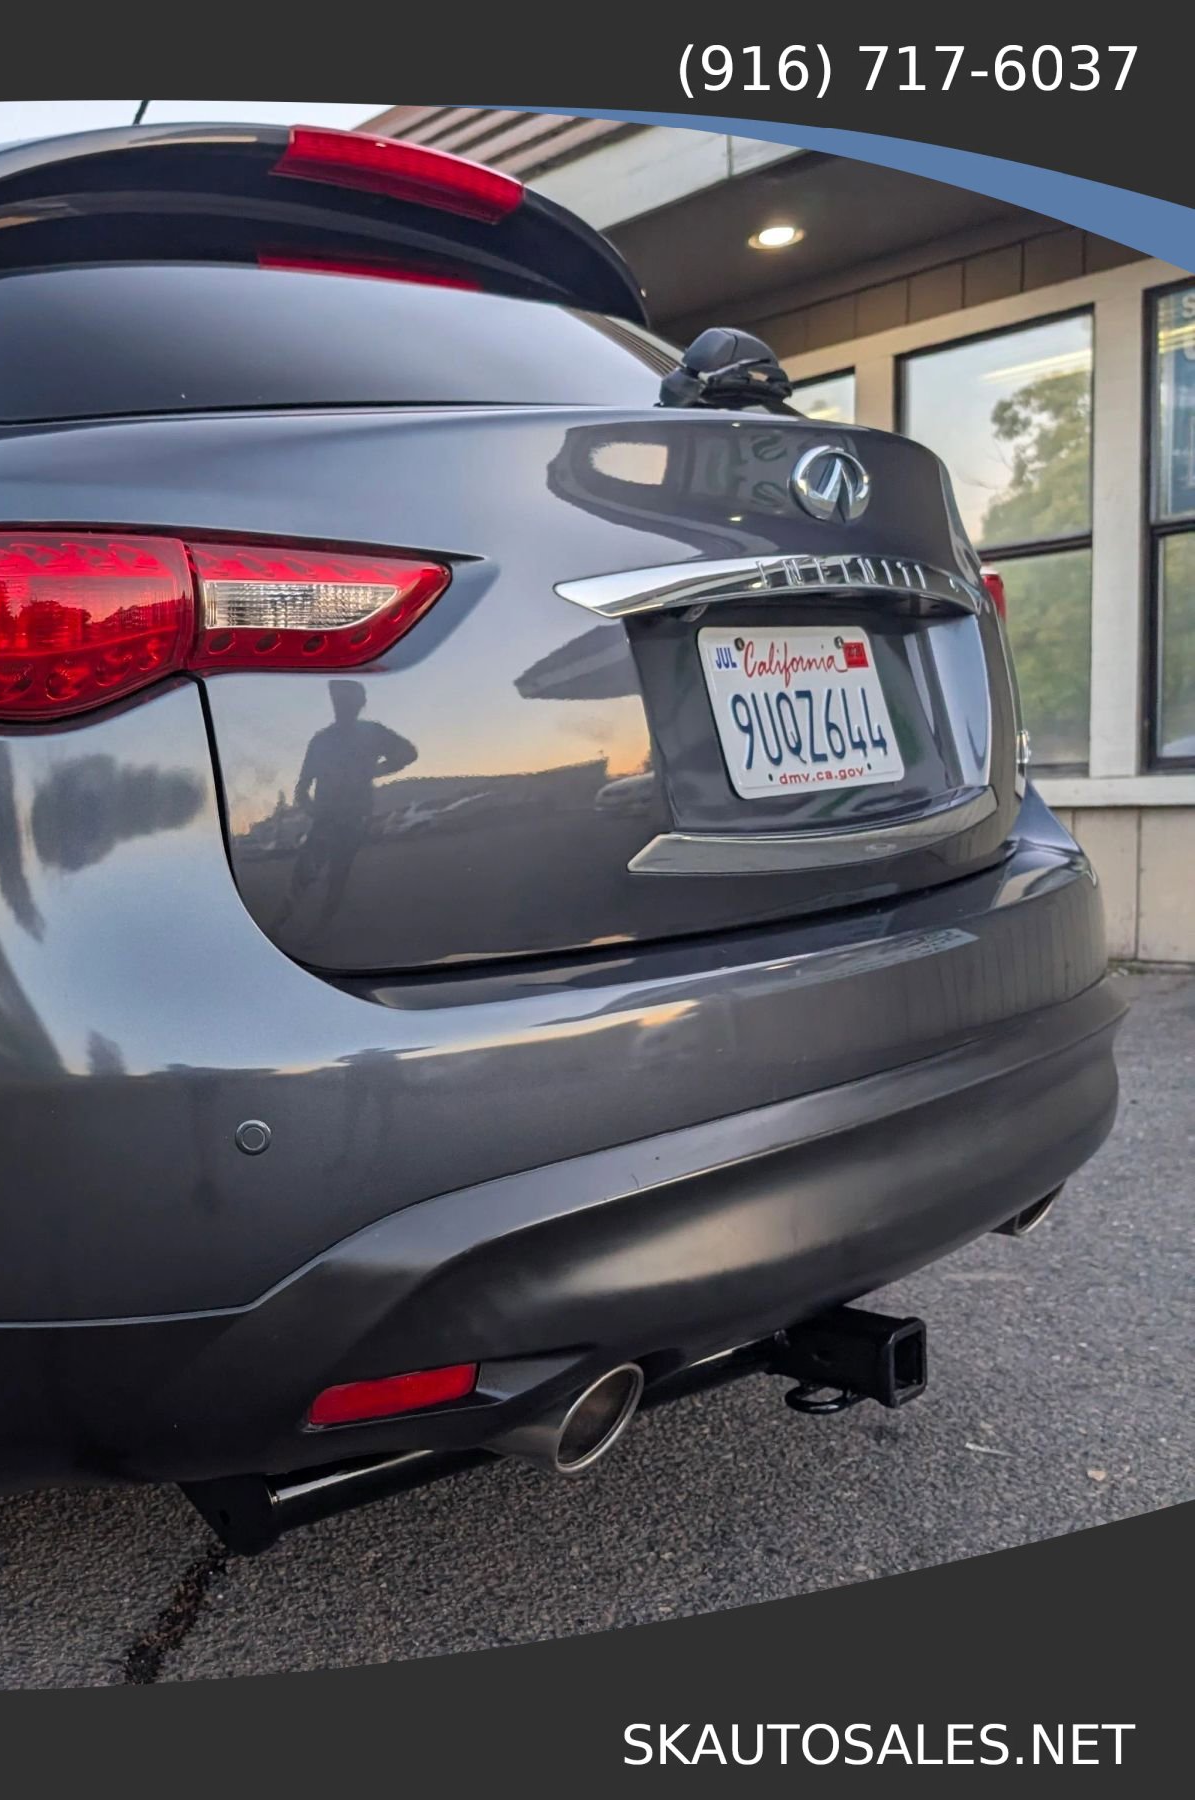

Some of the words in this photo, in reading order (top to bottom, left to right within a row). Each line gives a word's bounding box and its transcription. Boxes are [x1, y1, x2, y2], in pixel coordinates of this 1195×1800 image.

[716, 648, 738, 669] JUL
[744, 641, 848, 688] California
[731, 687, 888, 770] 9UQZ644
[779, 766, 865, 785] dmv.ca.gov
